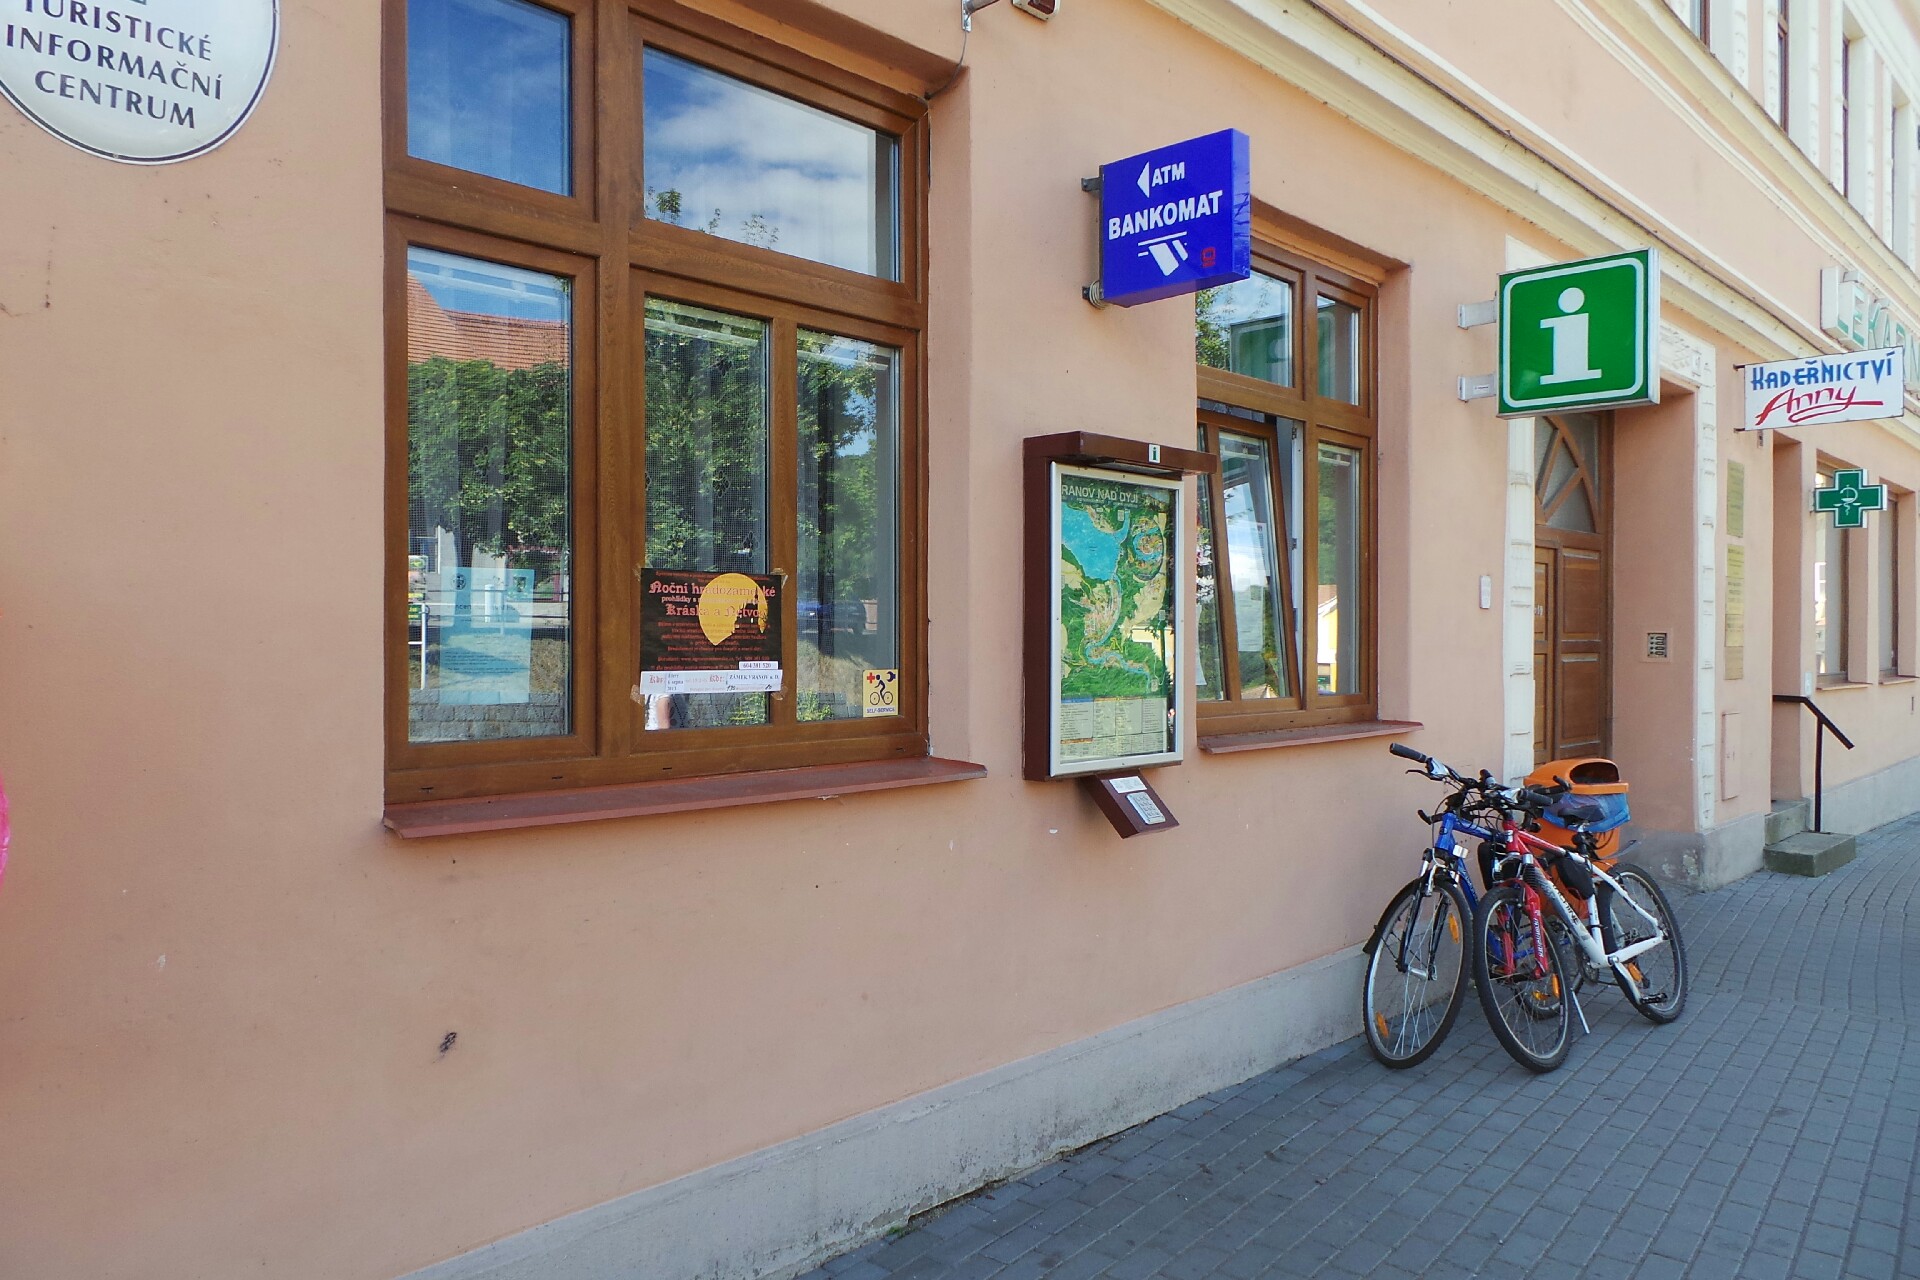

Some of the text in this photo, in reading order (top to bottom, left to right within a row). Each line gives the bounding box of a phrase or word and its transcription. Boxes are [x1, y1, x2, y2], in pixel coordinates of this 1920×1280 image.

[6, 24, 223, 100] INFORMAČNÍ
[34, 70, 196, 129] CENTRUM
[1151, 161, 1185, 187] ATM
[1108, 190, 1223, 241] BANKOMAT
[1540, 287, 1602, 385] i
[1750, 351, 1896, 391] KADEŘNICTVÍ
[1755, 386, 1884, 426] Anny
[1098, 489, 1117, 501] NAD
[1119, 492, 1139, 503] DYJI
[648, 580, 689, 594] Noční
[665, 603, 709, 616] Kráska
